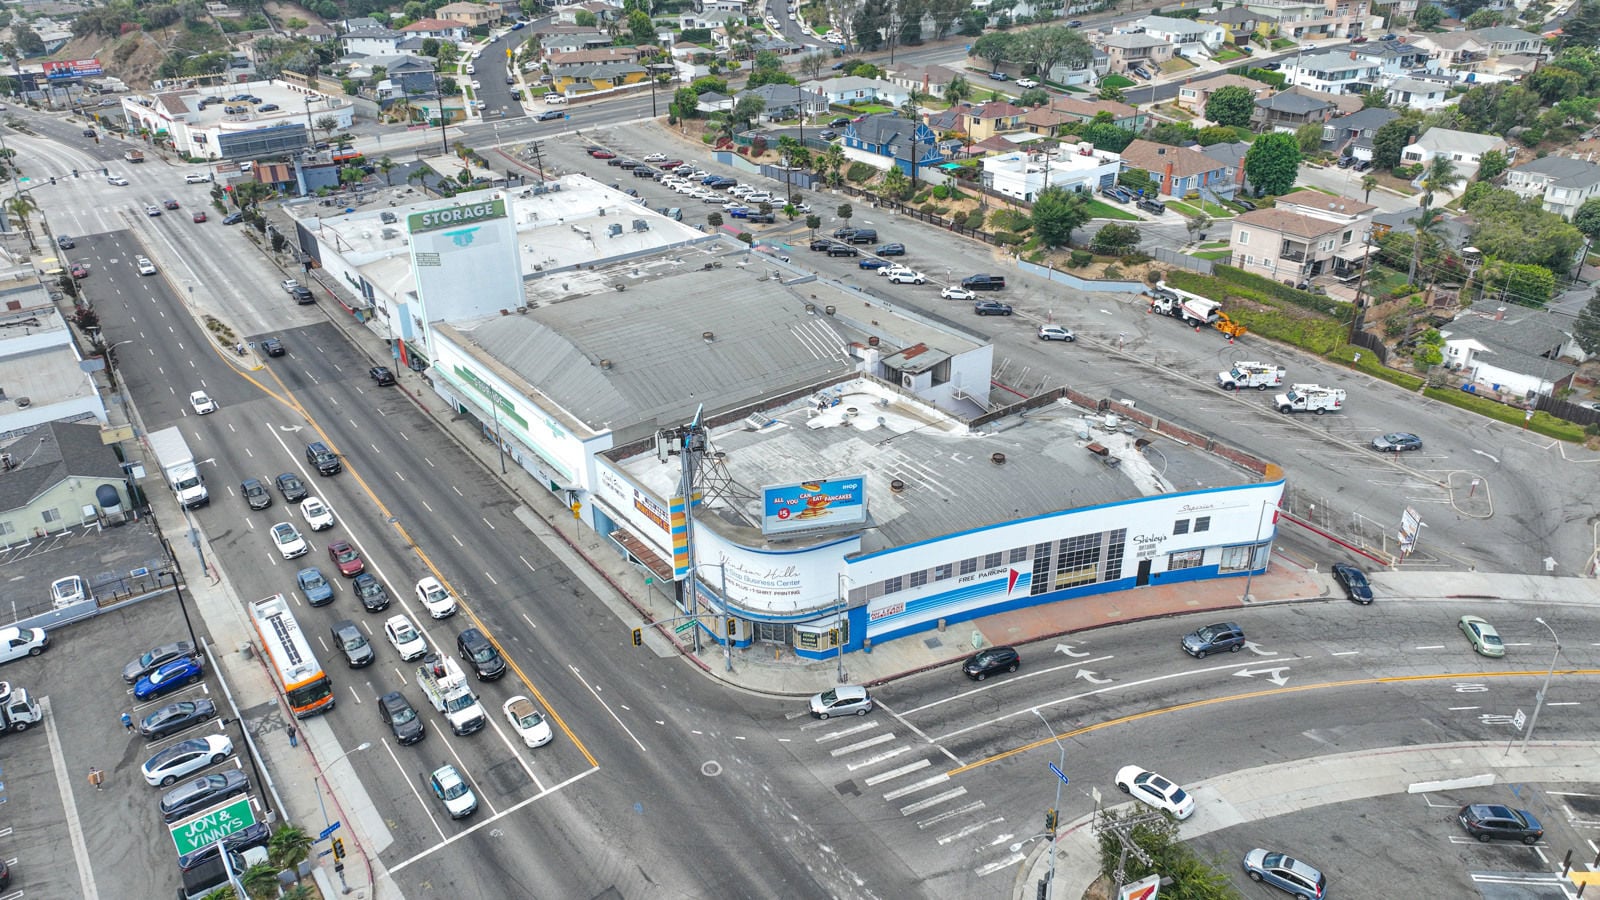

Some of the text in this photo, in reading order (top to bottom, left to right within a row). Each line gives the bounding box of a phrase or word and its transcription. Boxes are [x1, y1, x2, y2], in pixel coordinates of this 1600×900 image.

[422, 203, 494, 226] STORAGE
[824, 493, 853, 503] PANCAKES
[779, 510, 788, 518] $5
[1131, 532, 1168, 544] Shirley's
[718, 550, 801, 580] Windsor Hills
[743, 575, 776, 587] Business
[776, 578, 801, 587] Center
[958, 567, 1008, 584] FREE PARKING
[184, 810, 232, 838] JON &
[187, 817, 244, 848] VINNYS
